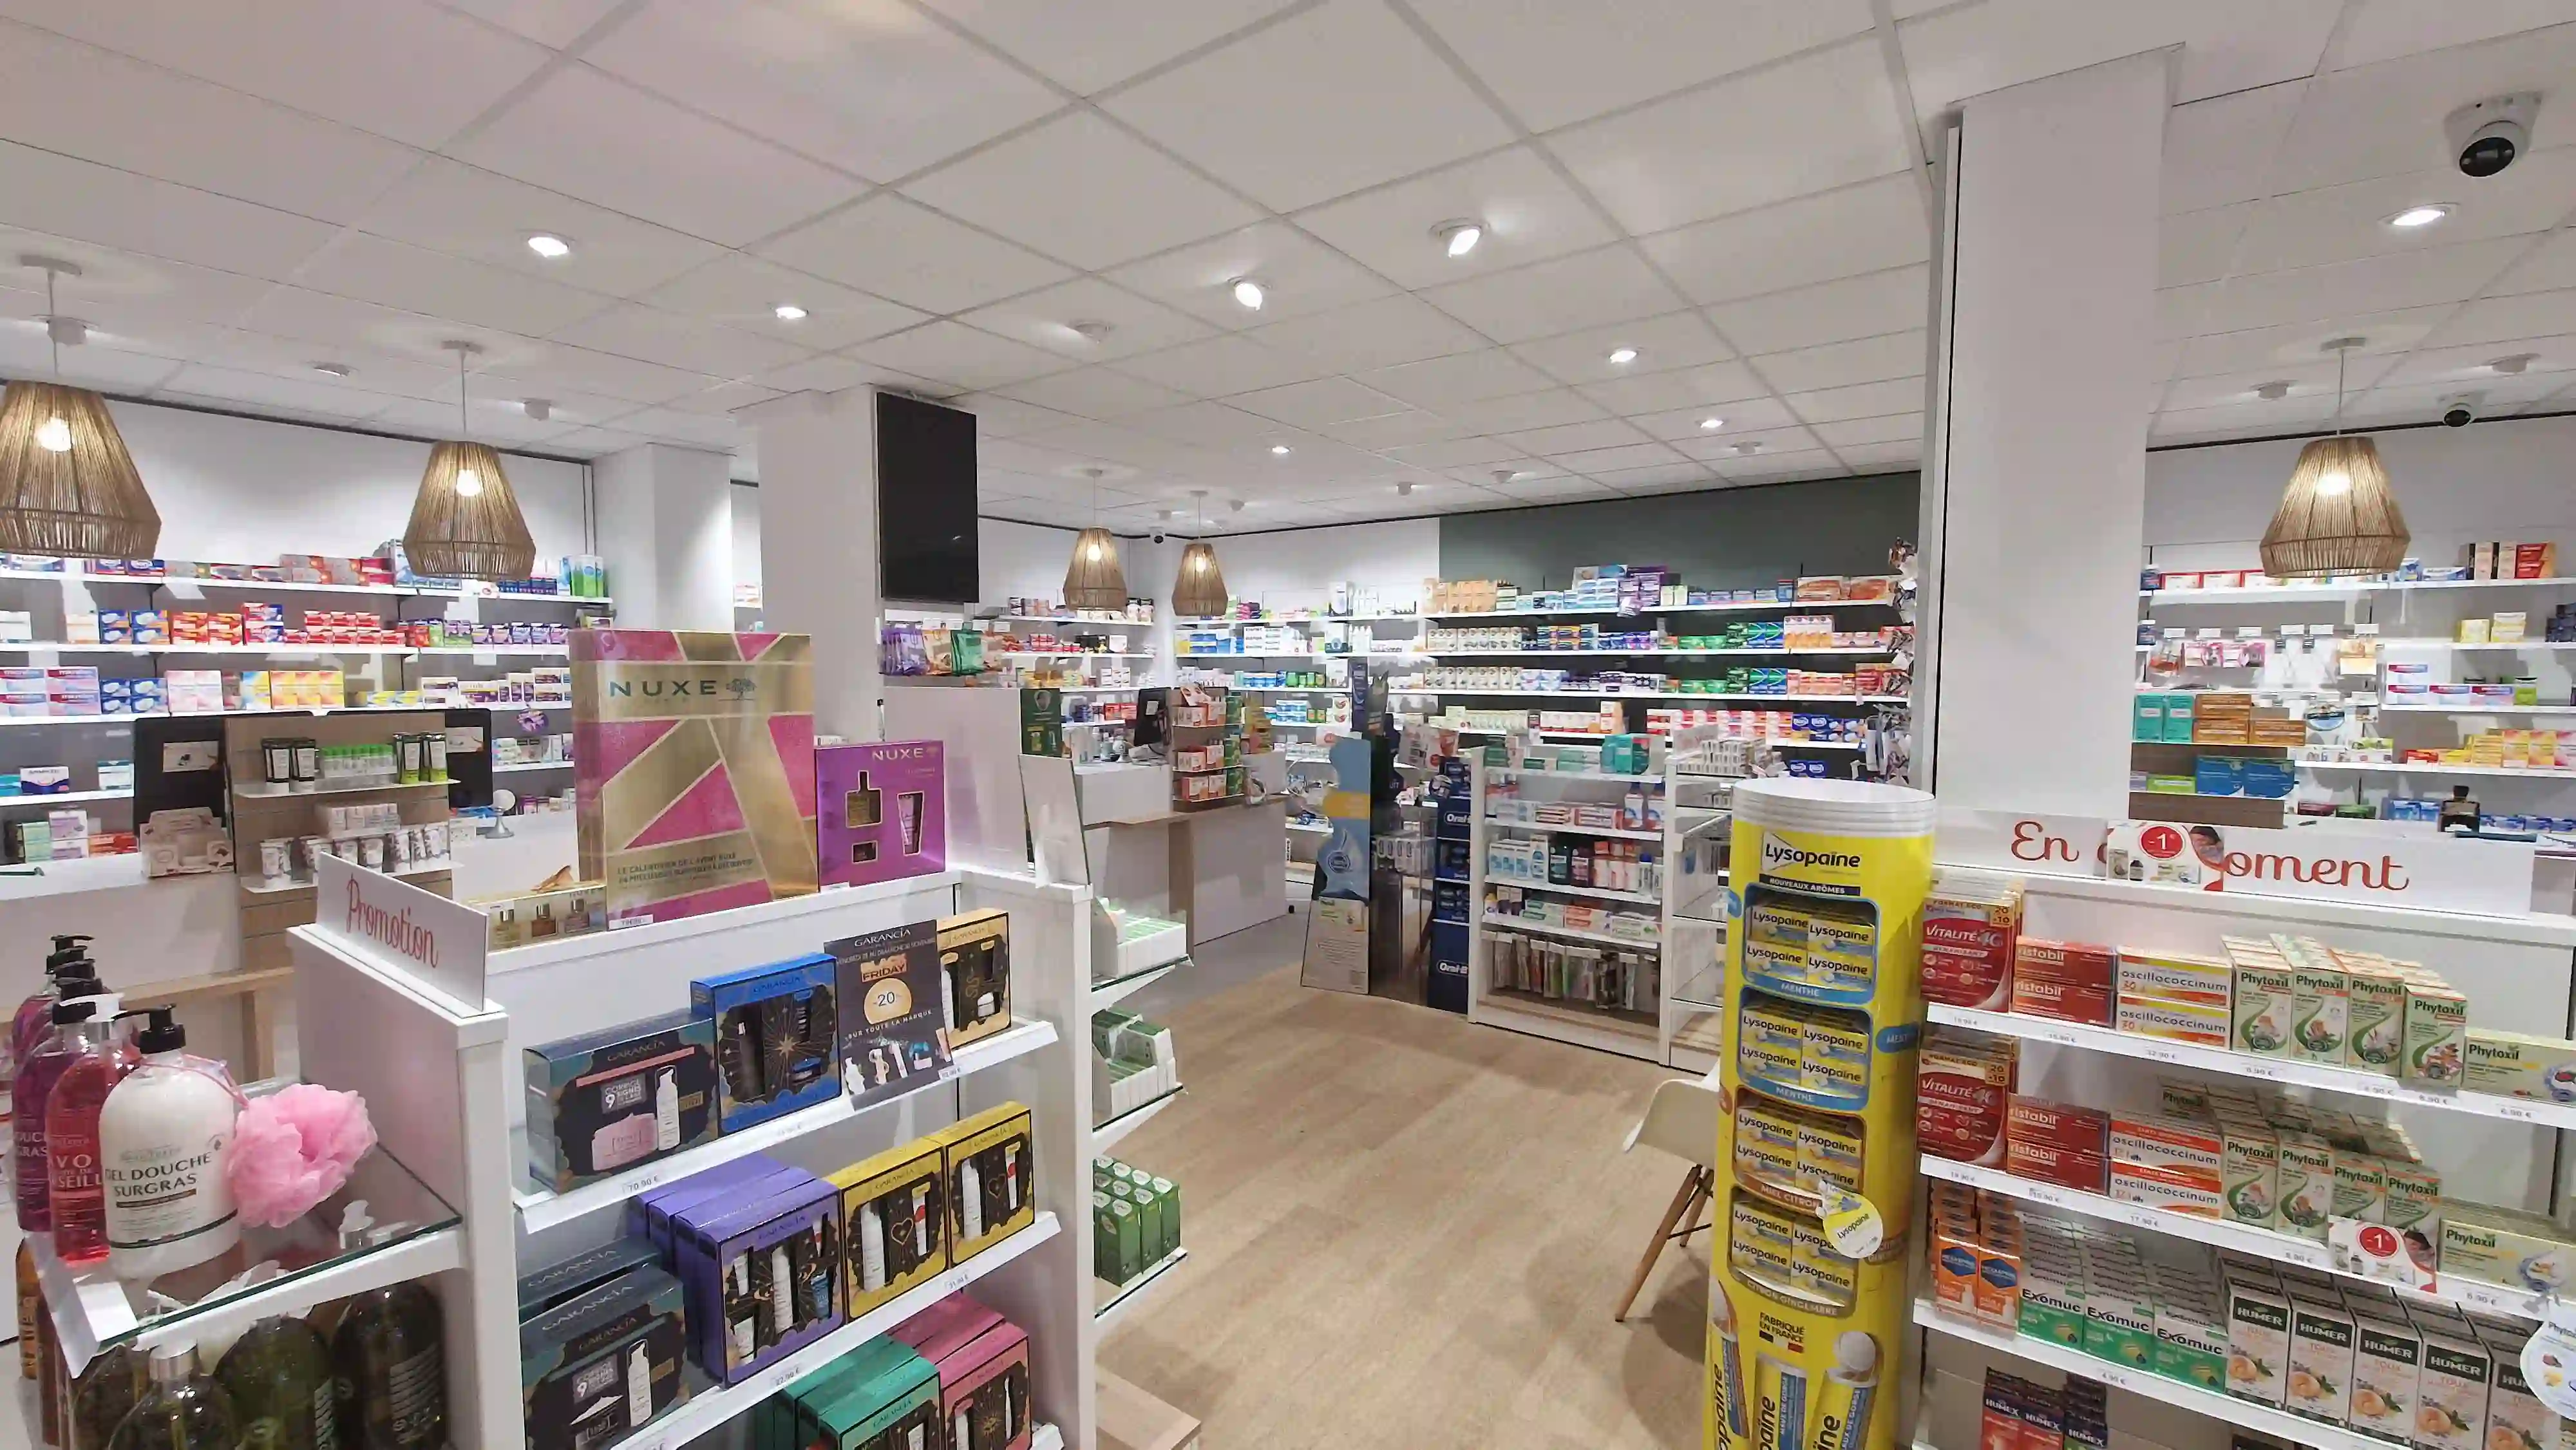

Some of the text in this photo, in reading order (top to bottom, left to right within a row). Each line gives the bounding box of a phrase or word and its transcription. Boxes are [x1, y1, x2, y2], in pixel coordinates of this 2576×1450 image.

[609, 680, 717, 697] NUXE
[872, 748, 924, 761] NUXE
[2010, 820, 2079, 863] En
[2224, 851, 2410, 891] oment
[346, 872, 439, 968] Promotion
[1926, 925, 1977, 942] VITALITÉ
[862, 964, 906, 981] FRIDAY
[2122, 971, 2227, 992] oscillococcinum
[2240, 972, 2289, 988] Phytoxil
[2296, 975, 2344, 990] Phytoxil
[2352, 980, 2401, 995] Phytoxil
[2414, 999, 2464, 1015] Phytoxil
[2120, 1010, 2226, 1033] oscillococcinum
[2468, 1044, 2519, 1060] Phytoxil
[1922, 1077, 1973, 1098] VITALITÉ
[2112, 1136, 2217, 1165] oscillococcinum
[2227, 1142, 2274, 1160] Phytoxil
[2282, 1150, 2329, 1168] Phytoxil
[130, 1151, 213, 1181] DOUCHE
[114, 1173, 198, 1197] SURGRAS
[2334, 1166, 2382, 1186] Phytoxil
[2115, 1178, 2218, 1205] oscillococcinum
[2389, 1177, 2438, 1196] Phytoxil
[2445, 1229, 2496, 1248] Phytoxil
[2022, 1288, 2081, 1313] Exomuc
[2087, 1306, 2150, 1332] Exomuc
[2237, 1307, 2283, 1326] HUMER
[1772, 1326, 1804, 1343] FRANCE
[2157, 1328, 2223, 1355] Exomuc
[2300, 1323, 2348, 1342] HUMER
[2364, 1339, 2412, 1359] HUMER
[2430, 1356, 2481, 1376] HUMER
[1985, 1398, 2020, 1417] HUMEX
[2025, 1412, 2061, 1432] HUMEX
[2069, 1428, 2105, 1447] HUMEX
